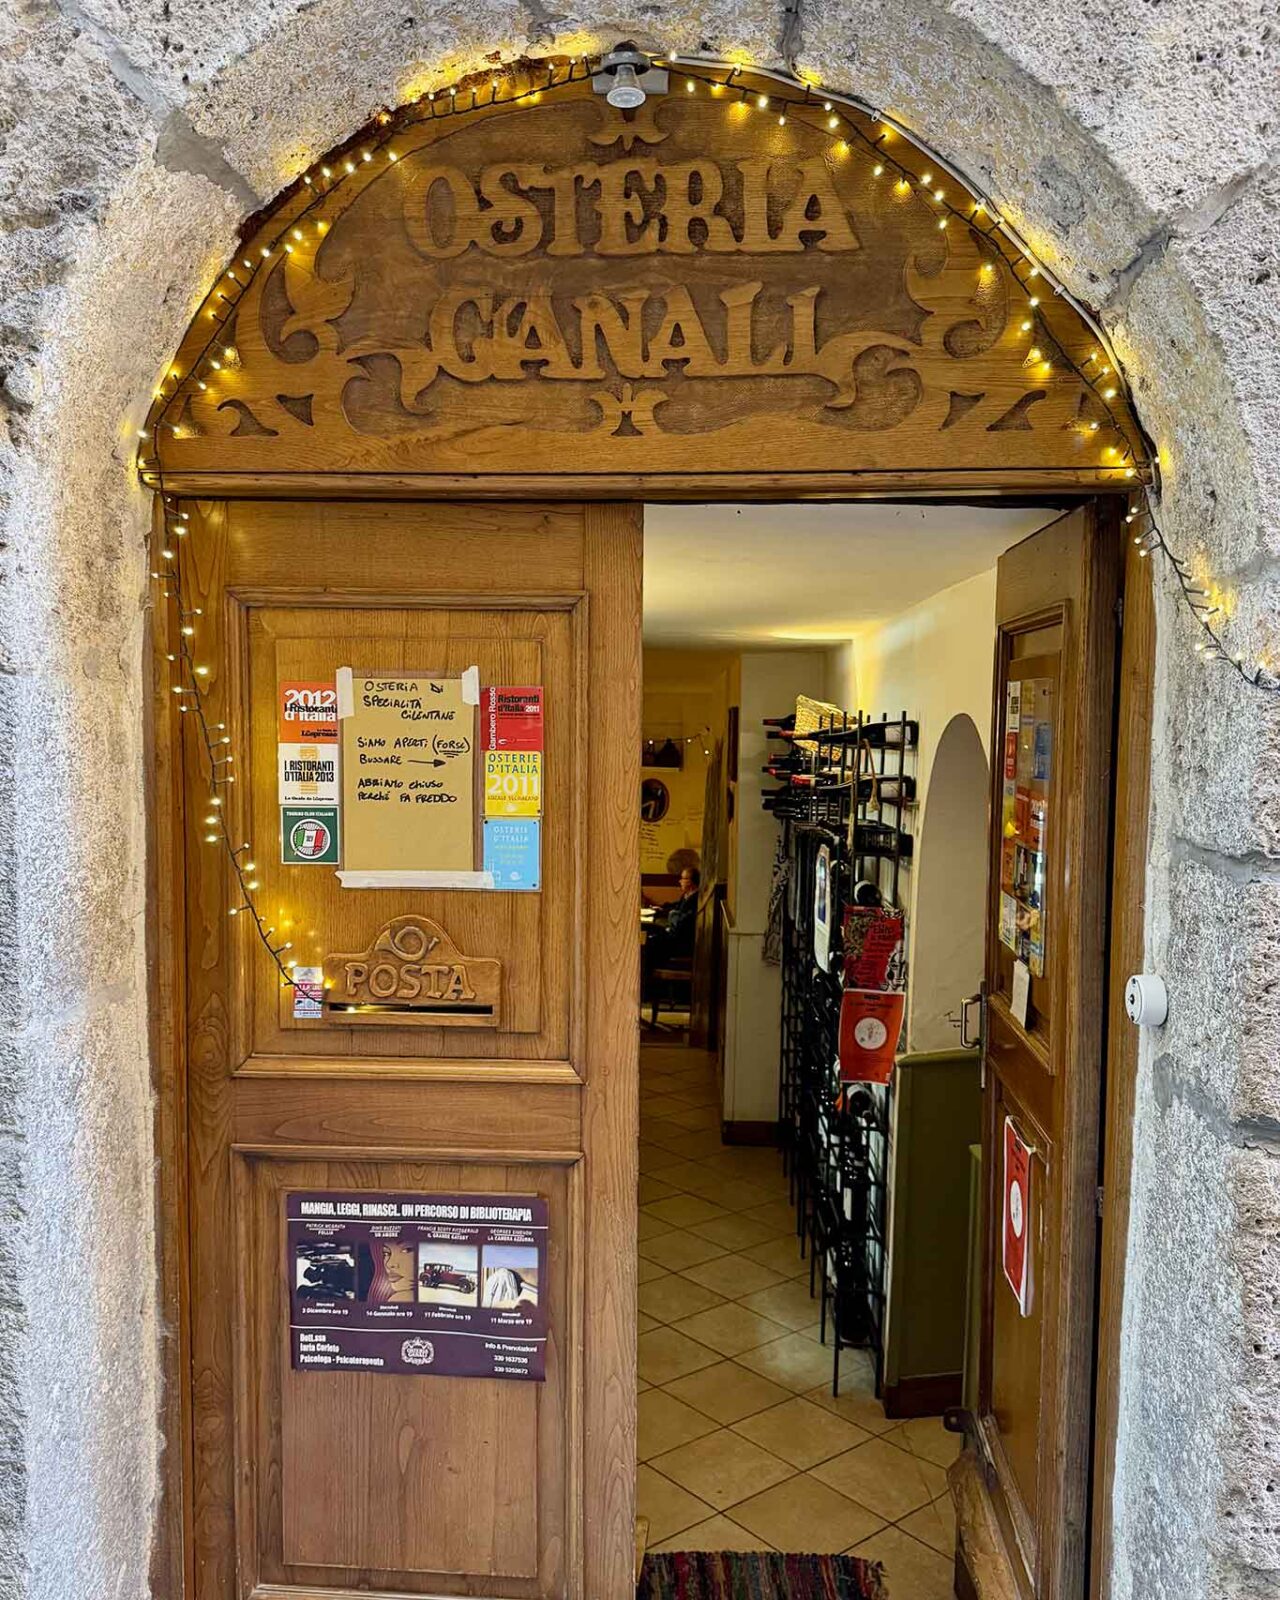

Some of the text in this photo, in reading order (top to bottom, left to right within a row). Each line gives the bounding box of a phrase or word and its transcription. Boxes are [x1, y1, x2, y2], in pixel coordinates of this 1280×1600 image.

[403, 158, 860, 258] OSTERIA
[428, 282, 820, 380] CANALI
[284, 689, 337, 707] 2012
[498, 694, 540, 703] Ristoranti
[290, 703, 338, 713] Ristoranti
[525, 704, 540, 712] 2011
[284, 711, 337, 721] d'Italia
[401, 710, 456, 721] CILENTANE
[488, 687, 496, 750] Gambero Rosso
[488, 754, 538, 763] OSTERIE
[284, 760, 334, 771] I RISTORANTI
[488, 764, 538, 774] D'ITALIA
[284, 771, 334, 782] D'ITALIA 2013
[488, 774, 539, 797] 2011
[400, 794, 410, 802] FA
[416, 793, 458, 803] FREDDO
[344, 961, 477, 1000] POSTA
[300, 1202, 336, 1216] MANGIA,
[337, 1202, 362, 1216] LEGGI,
[402, 1204, 414, 1217] UN
[415, 1204, 458, 1219] PERCORSO
[460, 1206, 469, 1219] DI
[470, 1207, 532, 1222] BIBLIOTERAPIA
[502, 1344, 537, 1352] Prenotazioni
[300, 1354, 332, 1364] Psicologa
[336, 1356, 384, 1366] Psicoterapeuta
